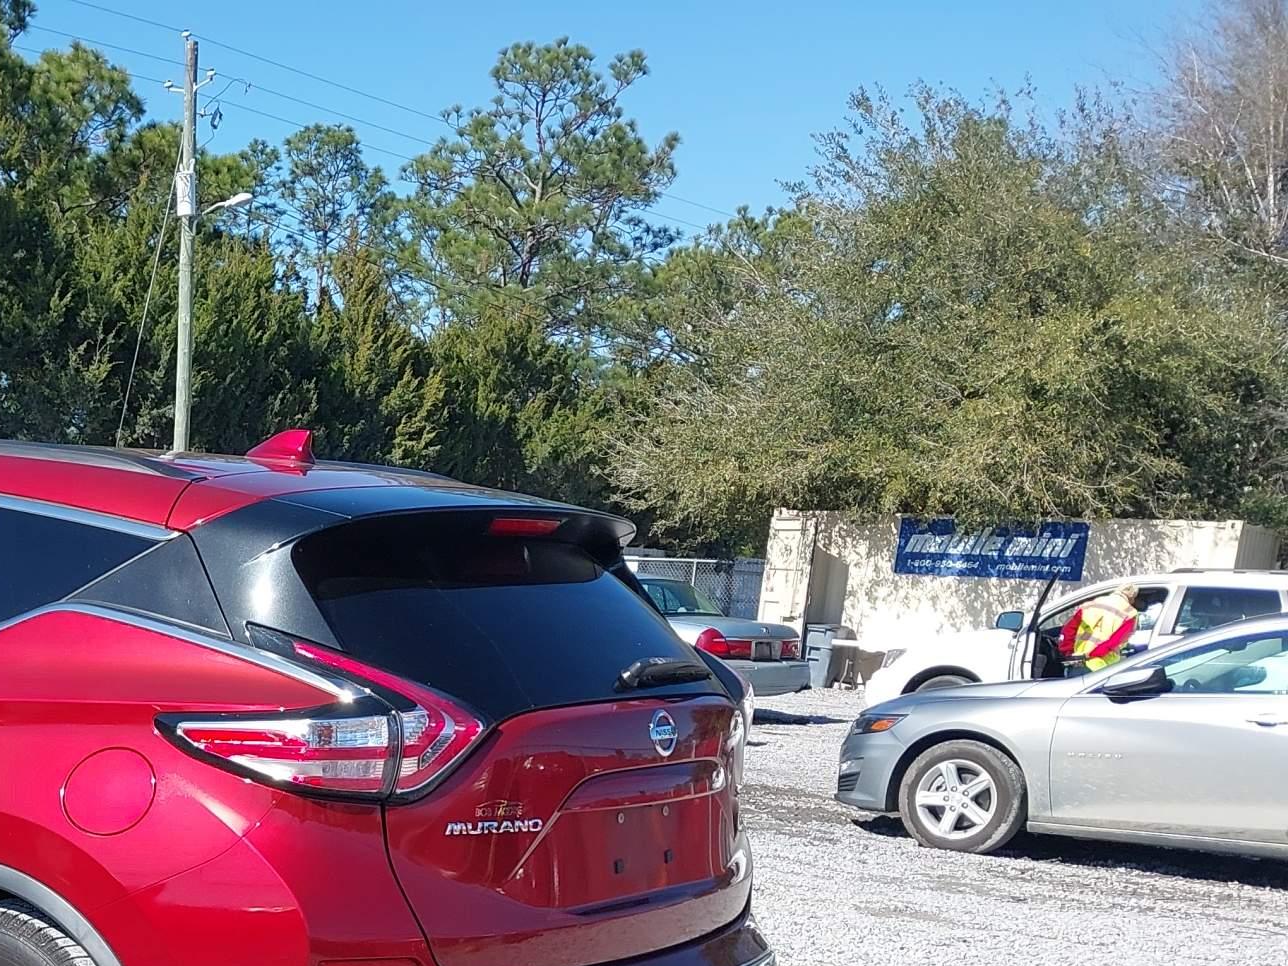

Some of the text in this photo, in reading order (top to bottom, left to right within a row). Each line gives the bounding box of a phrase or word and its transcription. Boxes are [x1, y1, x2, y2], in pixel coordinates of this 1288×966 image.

[905, 527, 1079, 558] mobile mini
[445, 818, 543, 836] MURANO
